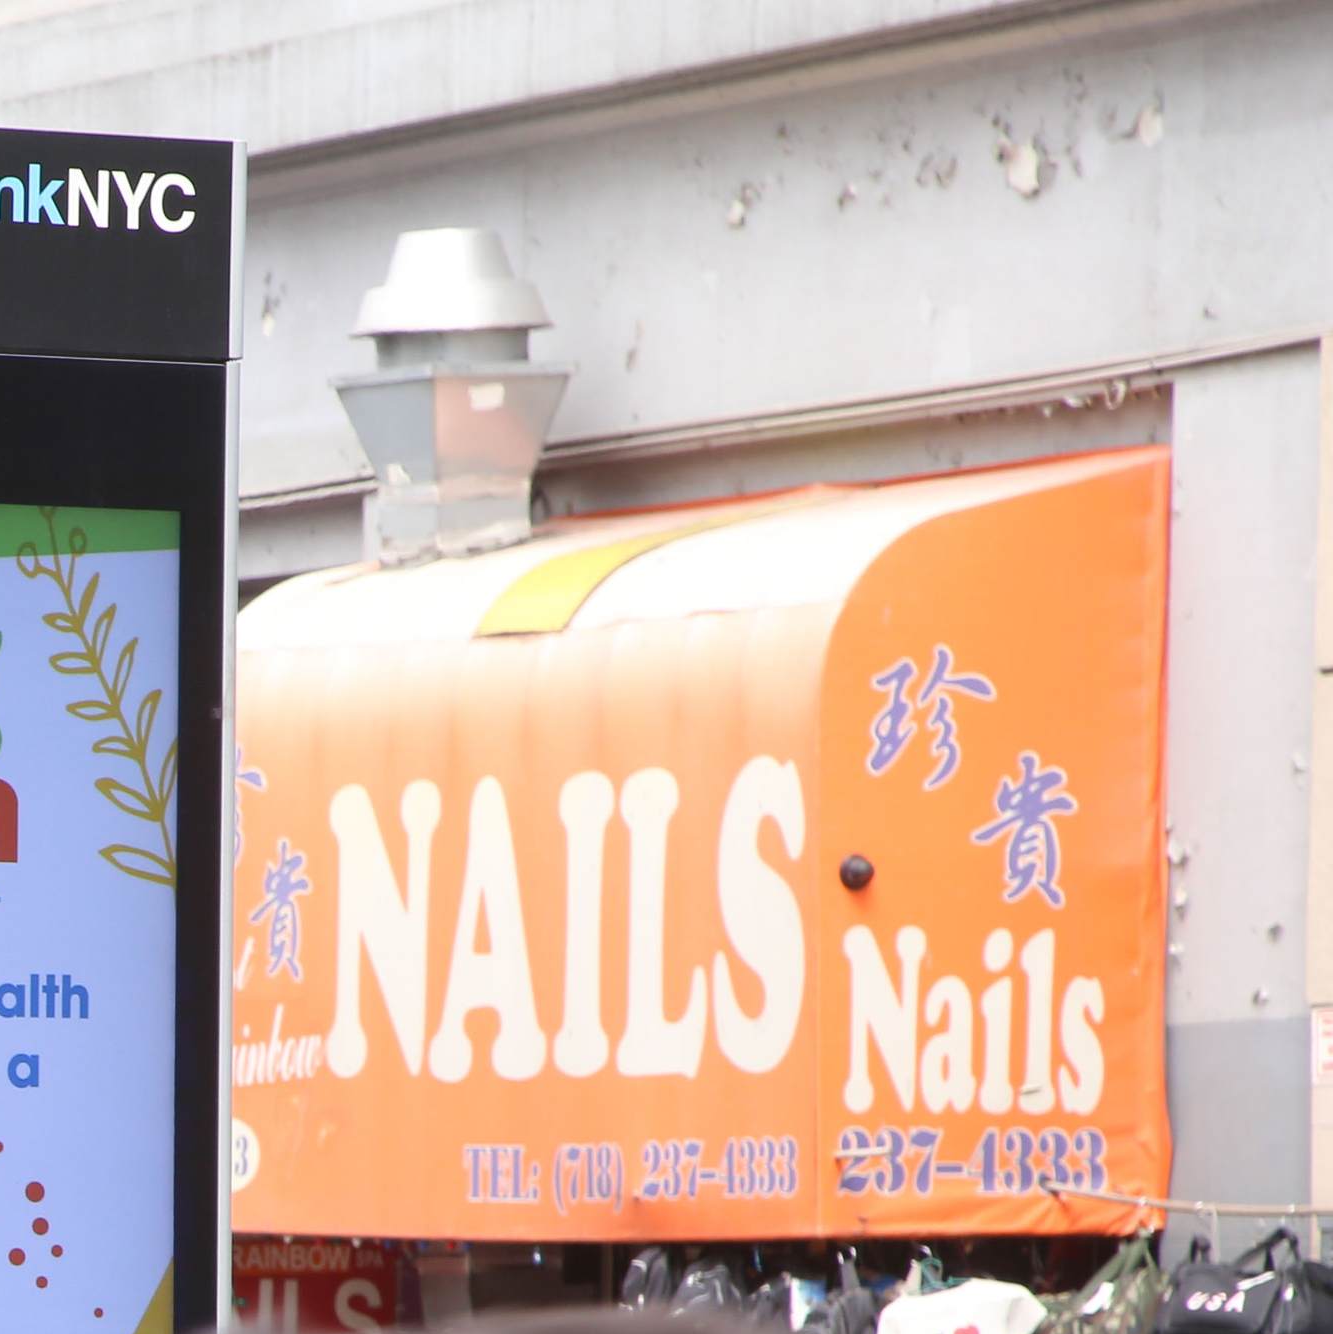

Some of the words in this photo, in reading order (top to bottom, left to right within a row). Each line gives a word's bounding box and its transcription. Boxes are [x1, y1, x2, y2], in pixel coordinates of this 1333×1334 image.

[327, 754, 805, 1083] NAILS
[844, 925, 1104, 1115] Nails
[7, 1053, 39, 1088] a
[463, 1143, 539, 1199] TEL:
[554, 1144, 624, 1213] (718)
[643, 1137, 797, 1198] 237-4333
[839, 1127, 1106, 1194] 237-4333
[1186, 1289, 1246, 1314] USA
